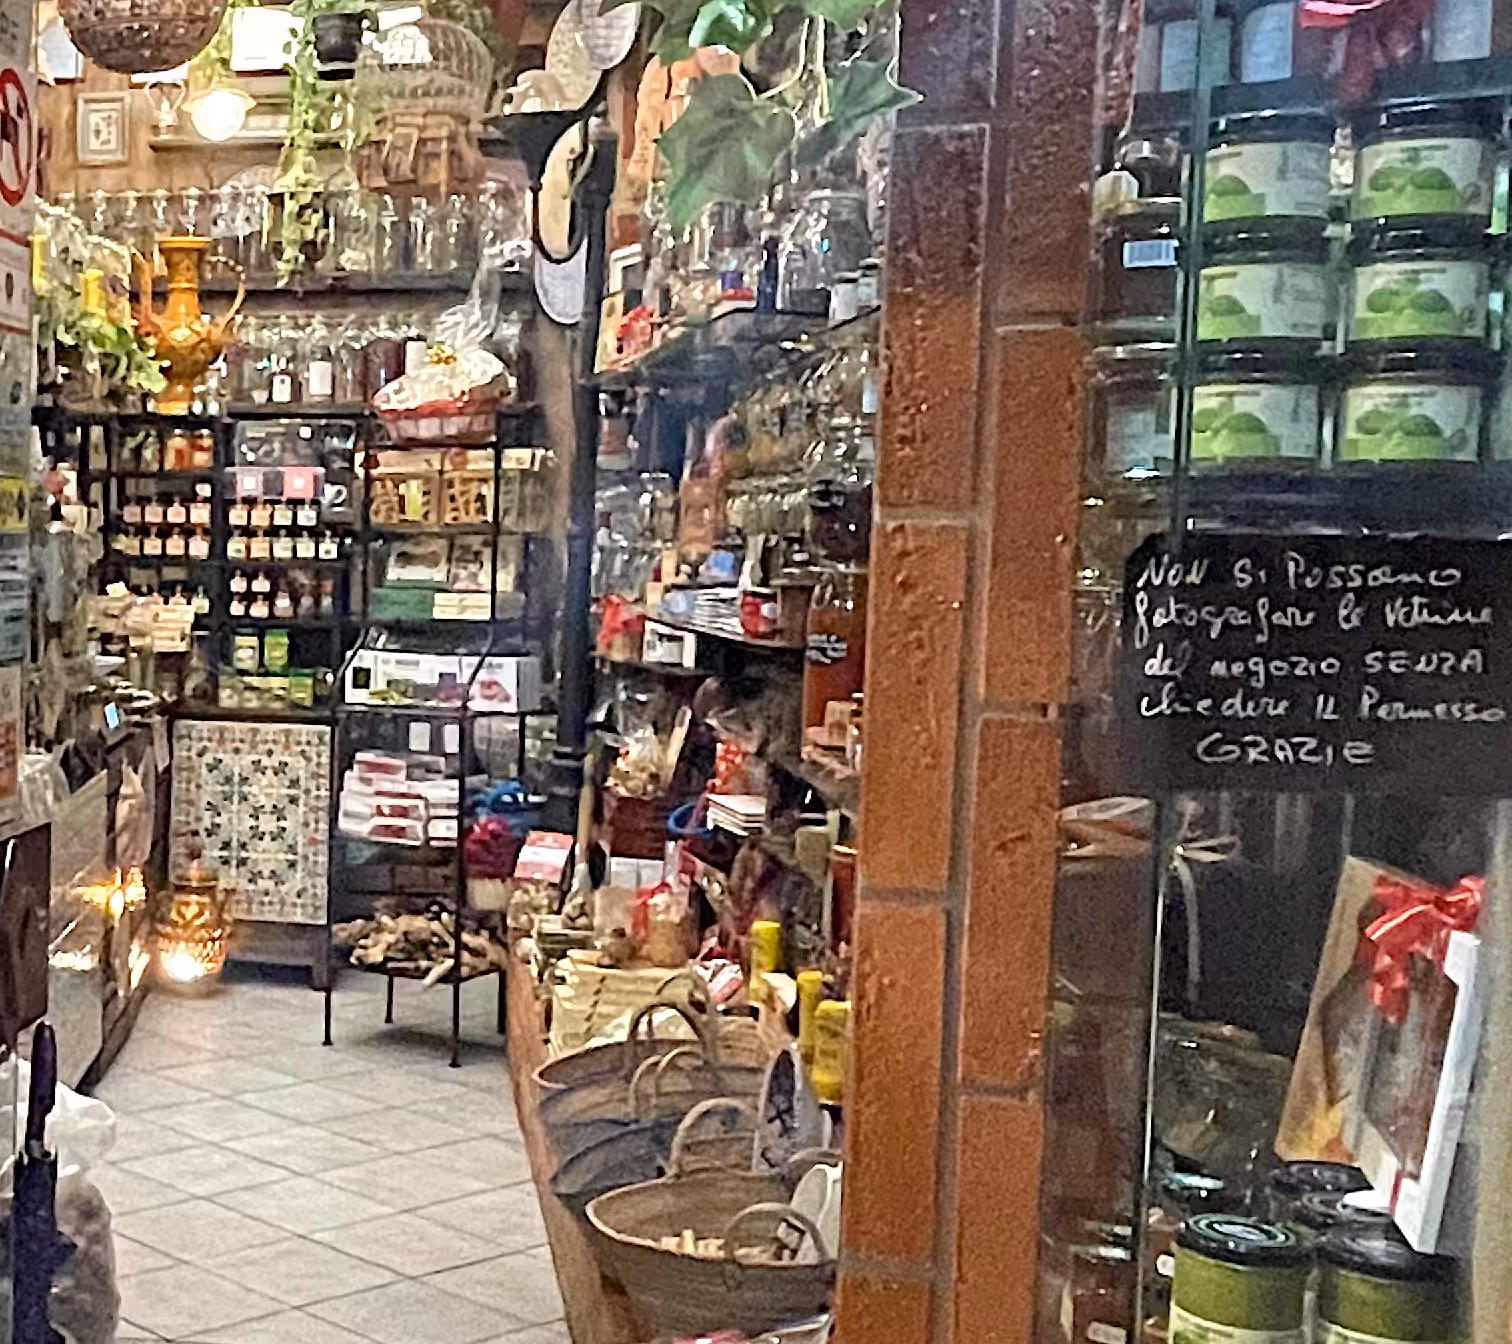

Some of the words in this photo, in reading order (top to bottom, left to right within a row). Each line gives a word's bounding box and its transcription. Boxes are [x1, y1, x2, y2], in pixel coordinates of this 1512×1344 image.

[1143, 641, 1190, 680] del
[1209, 656, 1341, 689] negozio
[1364, 648, 1484, 676] SENZA
